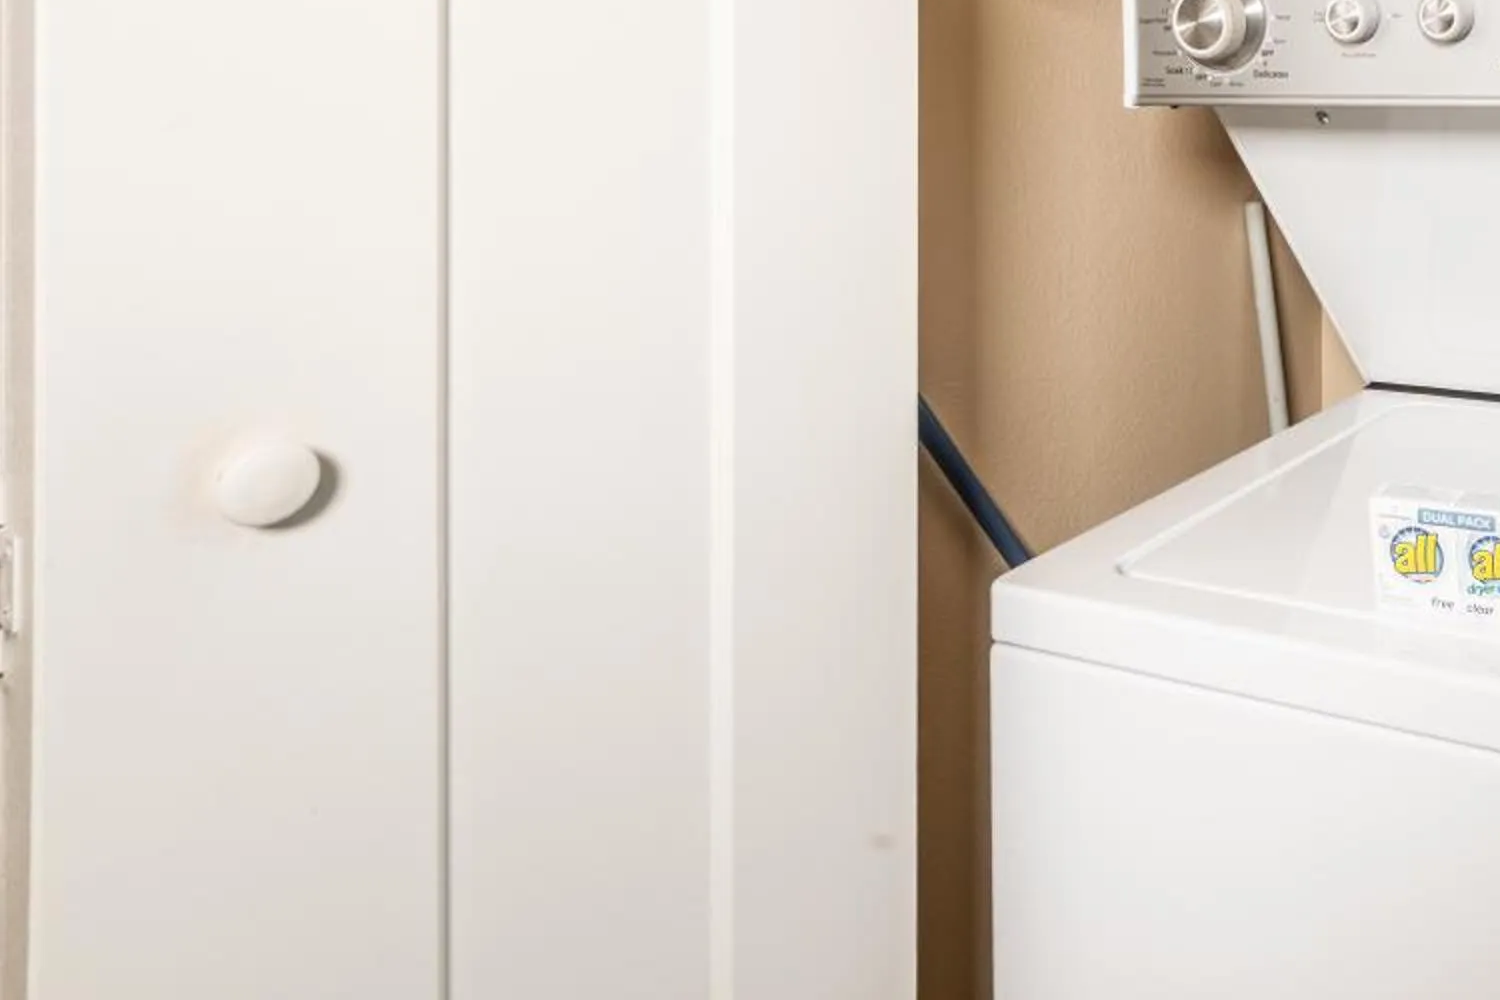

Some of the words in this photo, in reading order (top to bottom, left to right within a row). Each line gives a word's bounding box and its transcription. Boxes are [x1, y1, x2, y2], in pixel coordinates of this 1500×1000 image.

[1422, 511, 1455, 525] DUAL
[1457, 516, 1492, 530] PACK
[1394, 532, 1439, 574] all
[1467, 583, 1495, 596] dryer
